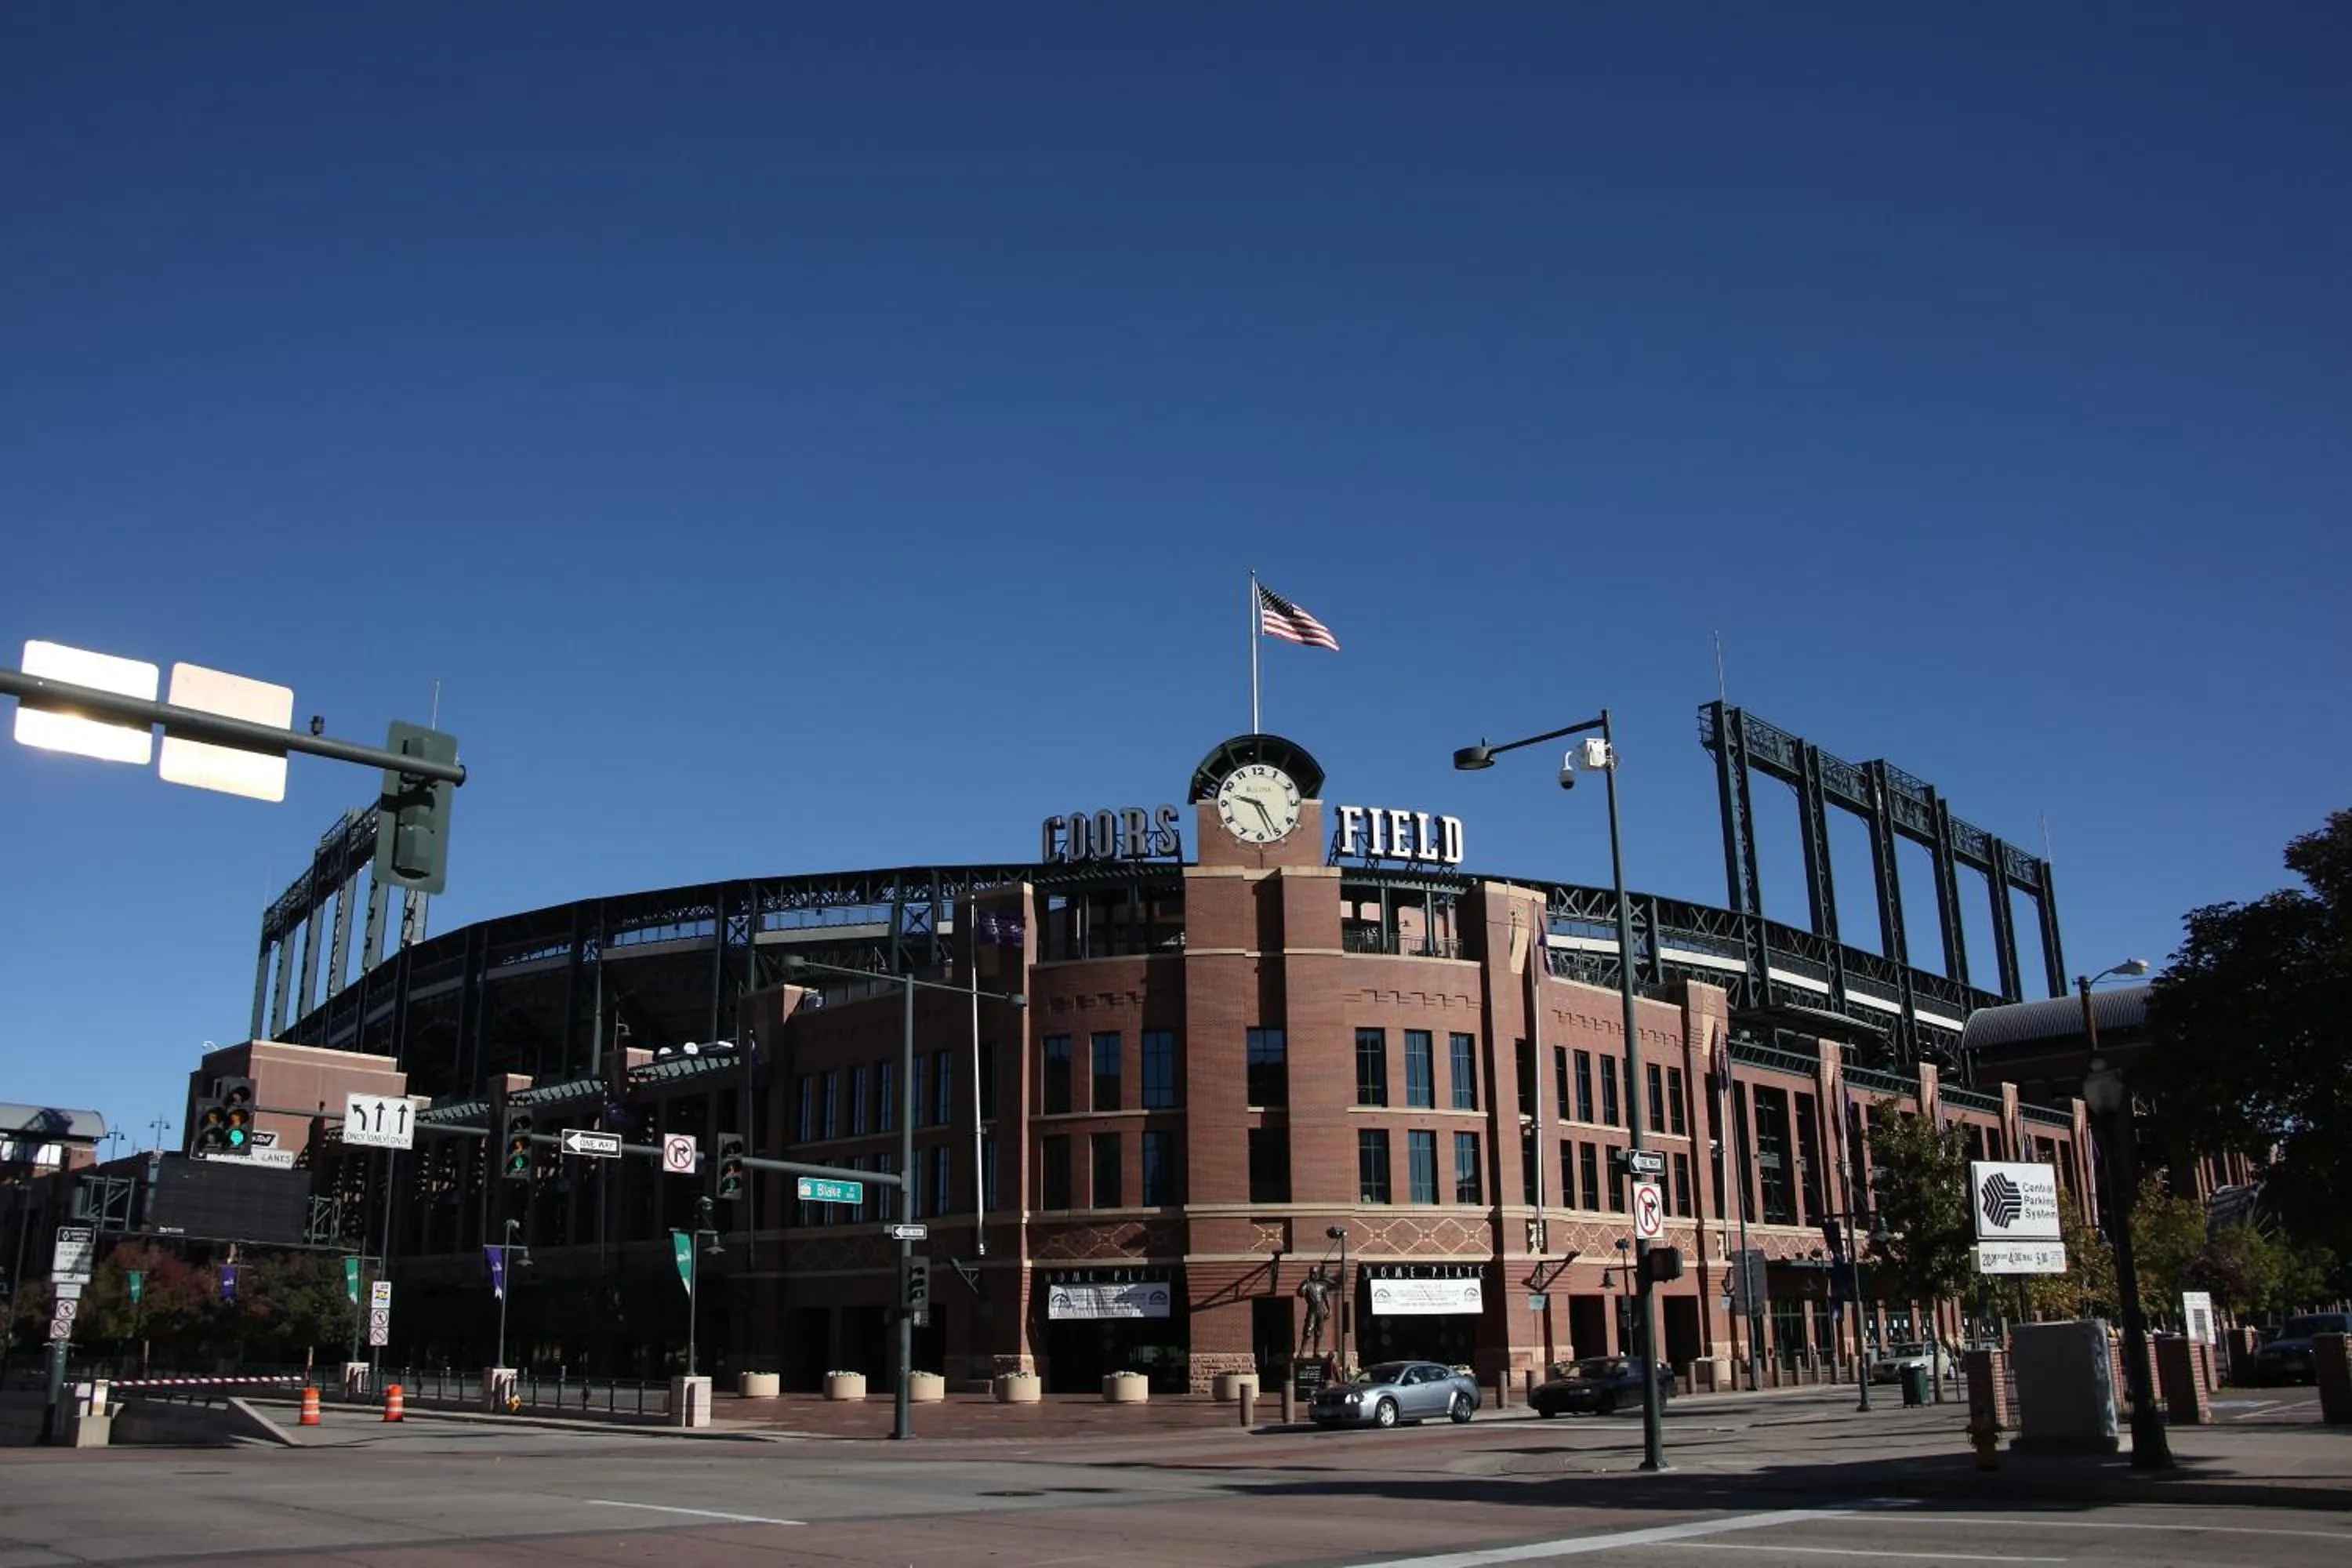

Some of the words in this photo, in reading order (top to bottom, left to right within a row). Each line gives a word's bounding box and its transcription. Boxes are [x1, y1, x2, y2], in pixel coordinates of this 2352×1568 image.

[1235, 771, 1247, 779] 11
[1223, 781, 1235, 793] 10
[1283, 782, 1293, 792] 2
[1043, 803, 1179, 862] COORS
[1336, 805, 1464, 863] FIELD
[346, 1132, 365, 1141] ONLY
[580, 1137, 595, 1148] ONE
[598, 1139, 614, 1149] WAY
[262, 1153, 291, 1163] LANES
[817, 1183, 841, 1197] Blake
[2022, 1181, 2054, 1192] Central
[2024, 1195, 2056, 1207] Parking
[1365, 1265, 1415, 1279] HOME
[1432, 1265, 1486, 1279] PLATE
